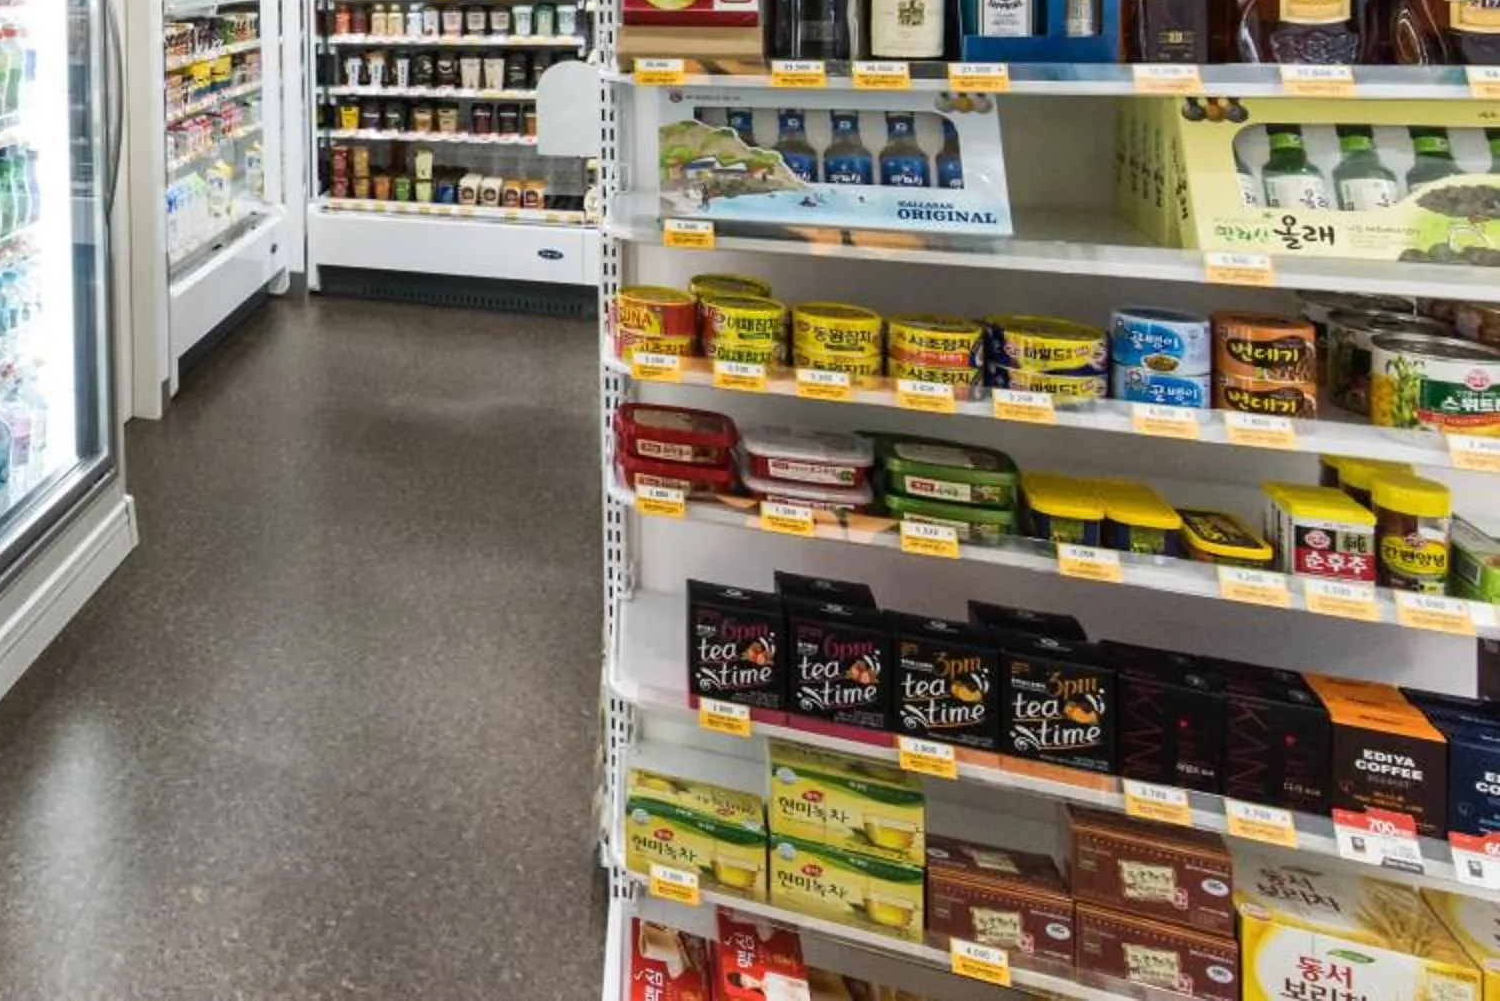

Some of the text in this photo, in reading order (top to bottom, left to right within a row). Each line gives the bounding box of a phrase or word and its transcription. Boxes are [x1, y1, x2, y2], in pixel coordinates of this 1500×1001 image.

[897, 207, 998, 226] ORIGINAL
[1273, 213, 1336, 251] 올래
[1230, 340, 1300, 362] 번데기
[1228, 389, 1298, 412] 번데기
[1442, 395, 1500, 412] 스위트
[1304, 552, 1368, 575] 순후추
[698, 640, 738, 663] tea
[718, 663, 774, 686] time
[798, 656, 840, 681] tea
[820, 682, 878, 705] time
[902, 673, 947, 697] tea
[924, 701, 986, 725] time
[1012, 694, 1060, 719] tea
[1037, 723, 1102, 747] time
[1362, 747, 1416, 769] EDIYA
[1354, 758, 1424, 783] COFFEE
[778, 796, 850, 824] 현미녹차
[1367, 818, 1394, 836] 700
[632, 833, 697, 862] 현미녹차
[777, 870, 848, 899] 현미녹차
[1298, 955, 1354, 989] 동서
